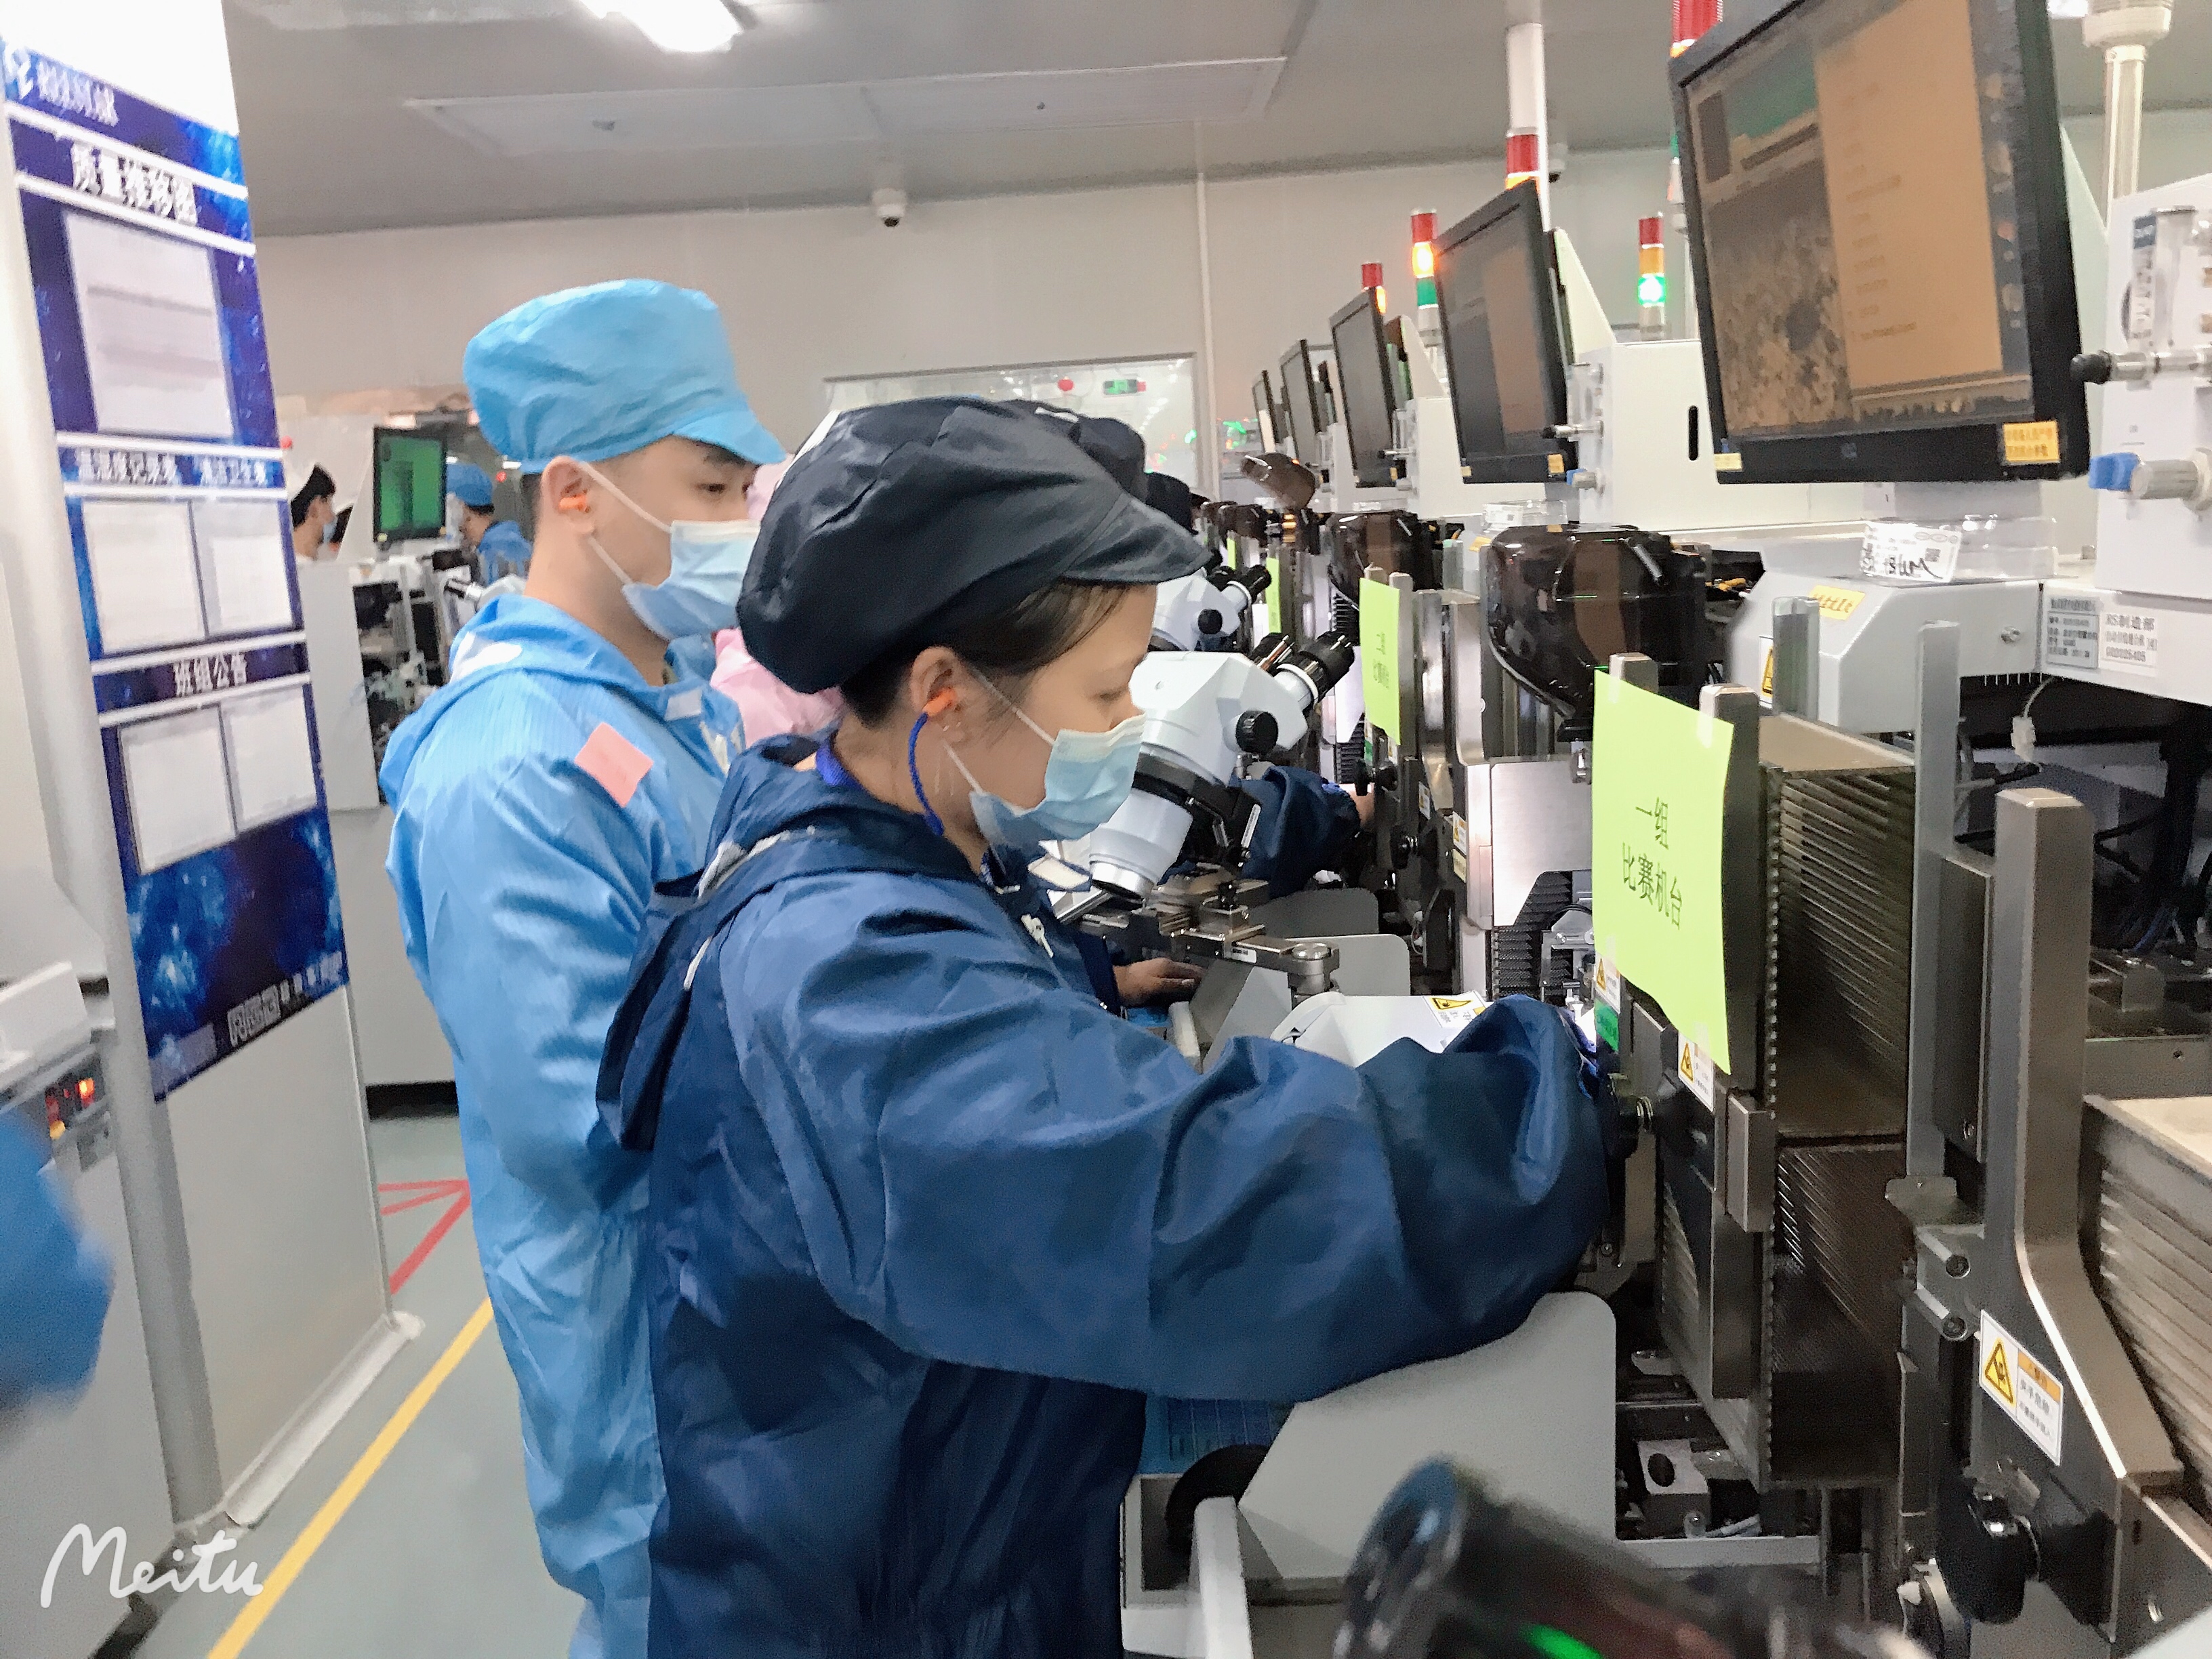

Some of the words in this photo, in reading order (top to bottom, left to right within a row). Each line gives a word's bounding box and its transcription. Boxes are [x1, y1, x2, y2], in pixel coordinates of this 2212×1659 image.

[1635, 797, 1668, 851] 一组
[1622, 842, 1682, 930] 比赛机台
